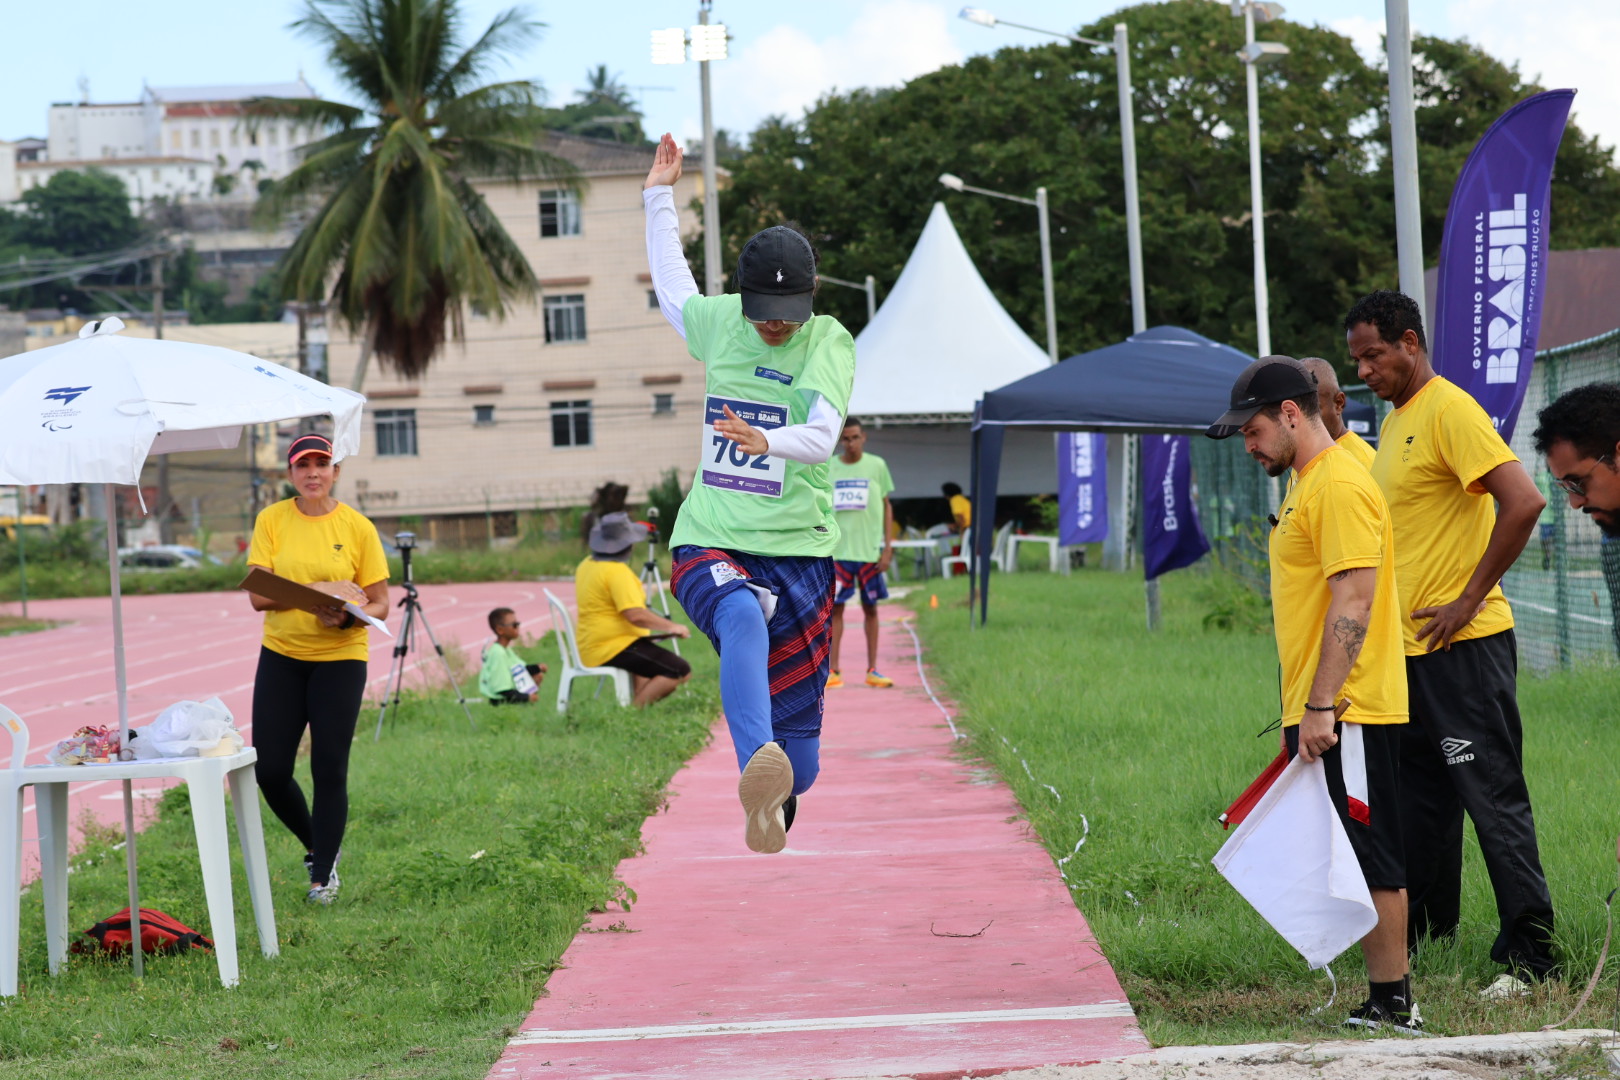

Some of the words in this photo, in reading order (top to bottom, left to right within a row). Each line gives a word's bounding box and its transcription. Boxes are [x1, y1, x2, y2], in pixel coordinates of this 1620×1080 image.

[1474, 211, 1484, 285] FEDERAL
[1485, 193, 1527, 385] BRASIL
[1472, 291, 1484, 370] GOVERNO
[838, 491, 864, 501] 704
